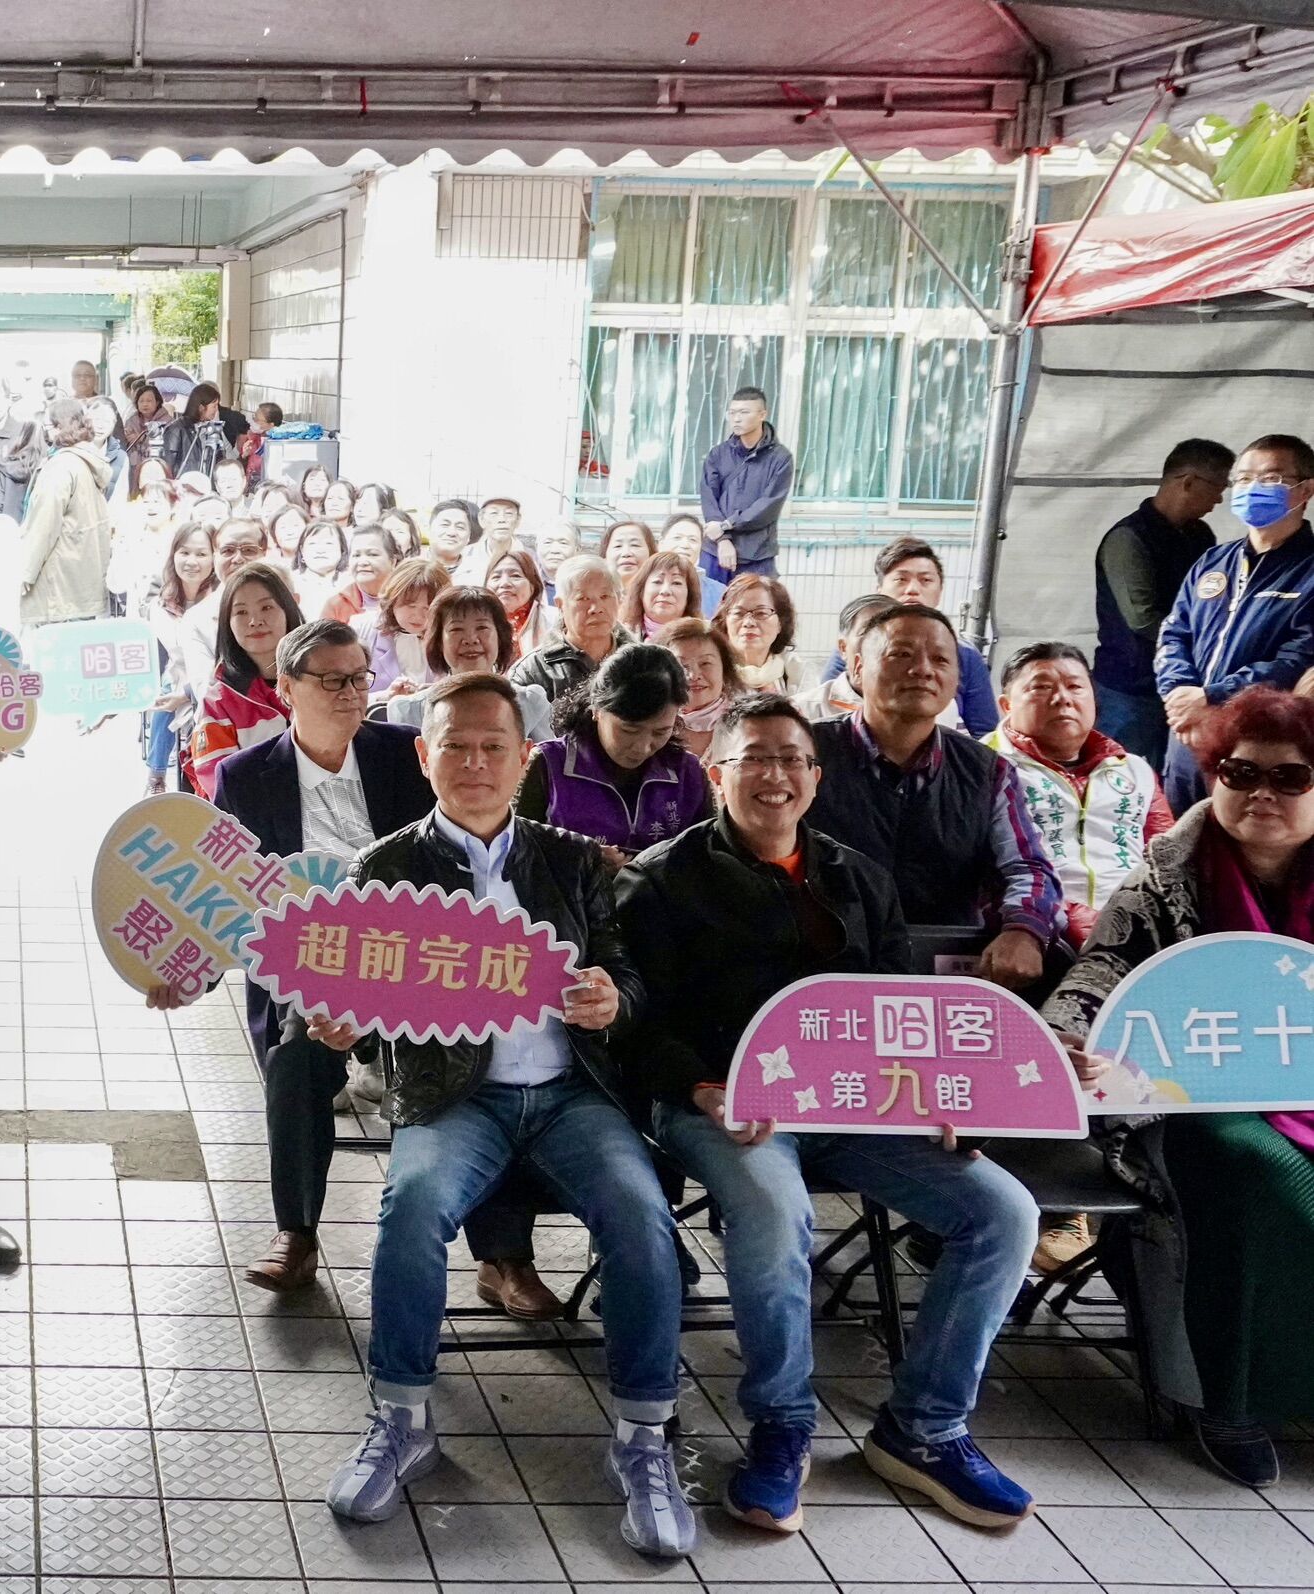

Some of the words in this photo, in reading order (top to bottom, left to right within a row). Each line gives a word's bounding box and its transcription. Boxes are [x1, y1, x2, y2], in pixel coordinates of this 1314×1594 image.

[197, 817, 287, 907] 新北
[113, 898, 216, 997] 聚點
[295, 921, 533, 997] 超前完成
[798, 1002, 997, 1054] 新北哈客
[1114, 1005, 1313, 1067] 八年十
[830, 1061, 973, 1117] 第九館
